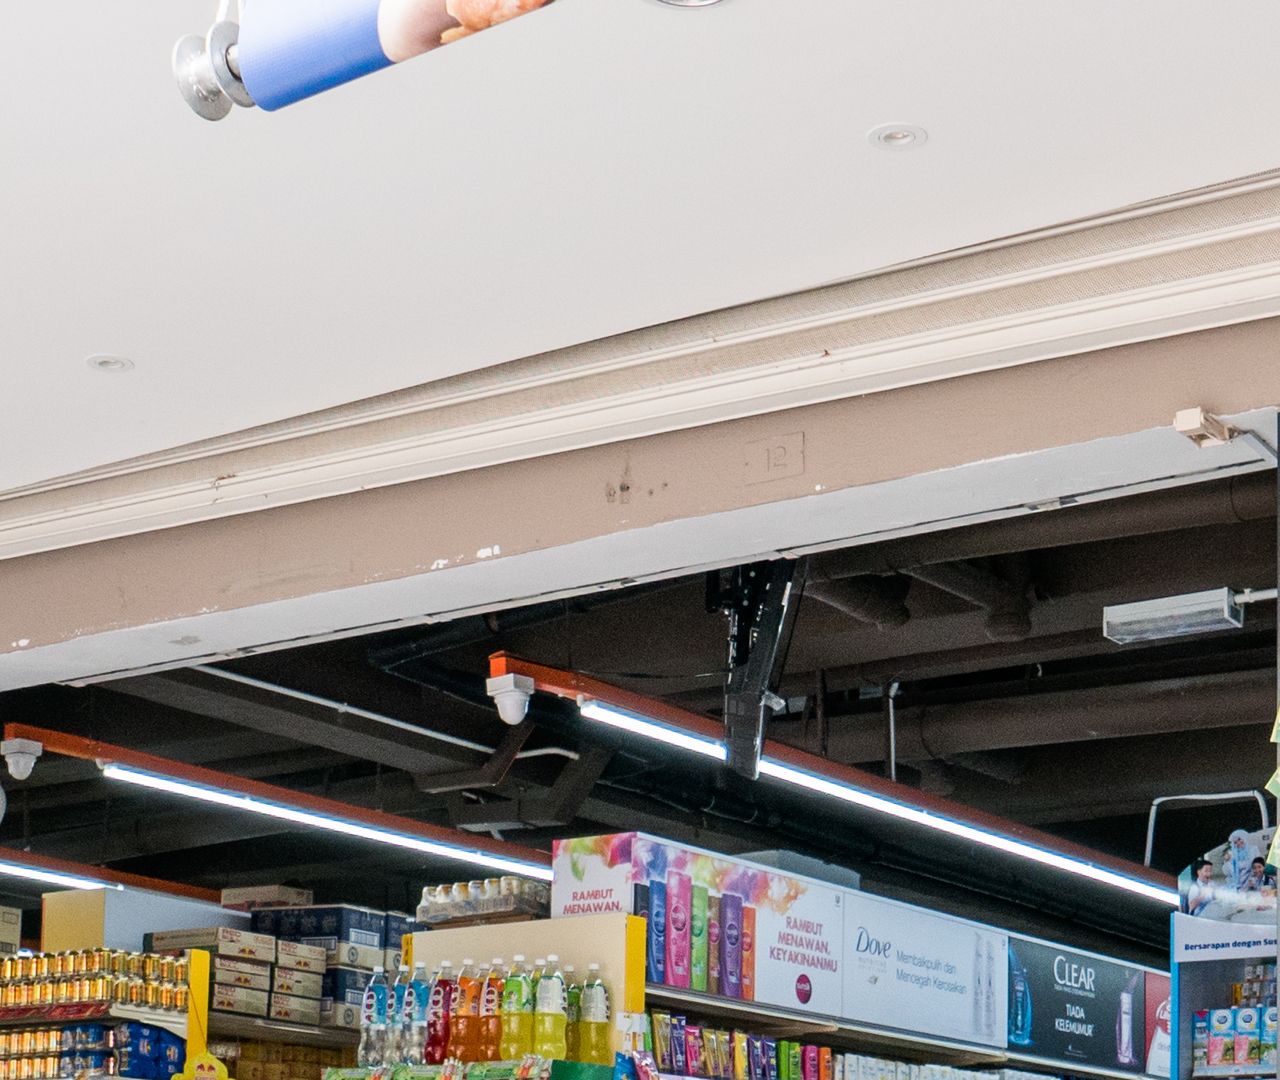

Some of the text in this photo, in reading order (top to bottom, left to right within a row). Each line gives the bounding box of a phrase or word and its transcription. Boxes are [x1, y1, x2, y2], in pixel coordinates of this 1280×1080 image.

[572, 888, 613, 901] RAMBUT
[562, 900, 623, 915] MENAWAN,
[785, 915, 823, 937] RAMBUT
[777, 932, 831, 956] MENAWAN,
[855, 926, 892, 959] Dove
[1184, 938, 1278, 951] Bersarapan dengan Sus
[768, 947, 839, 973] KEYAKINANMU
[1053, 955, 1096, 992] CLEAR
[1065, 1003, 1085, 1020] TIADA
[1055, 1018, 1094, 1037] KELEMUMUR
